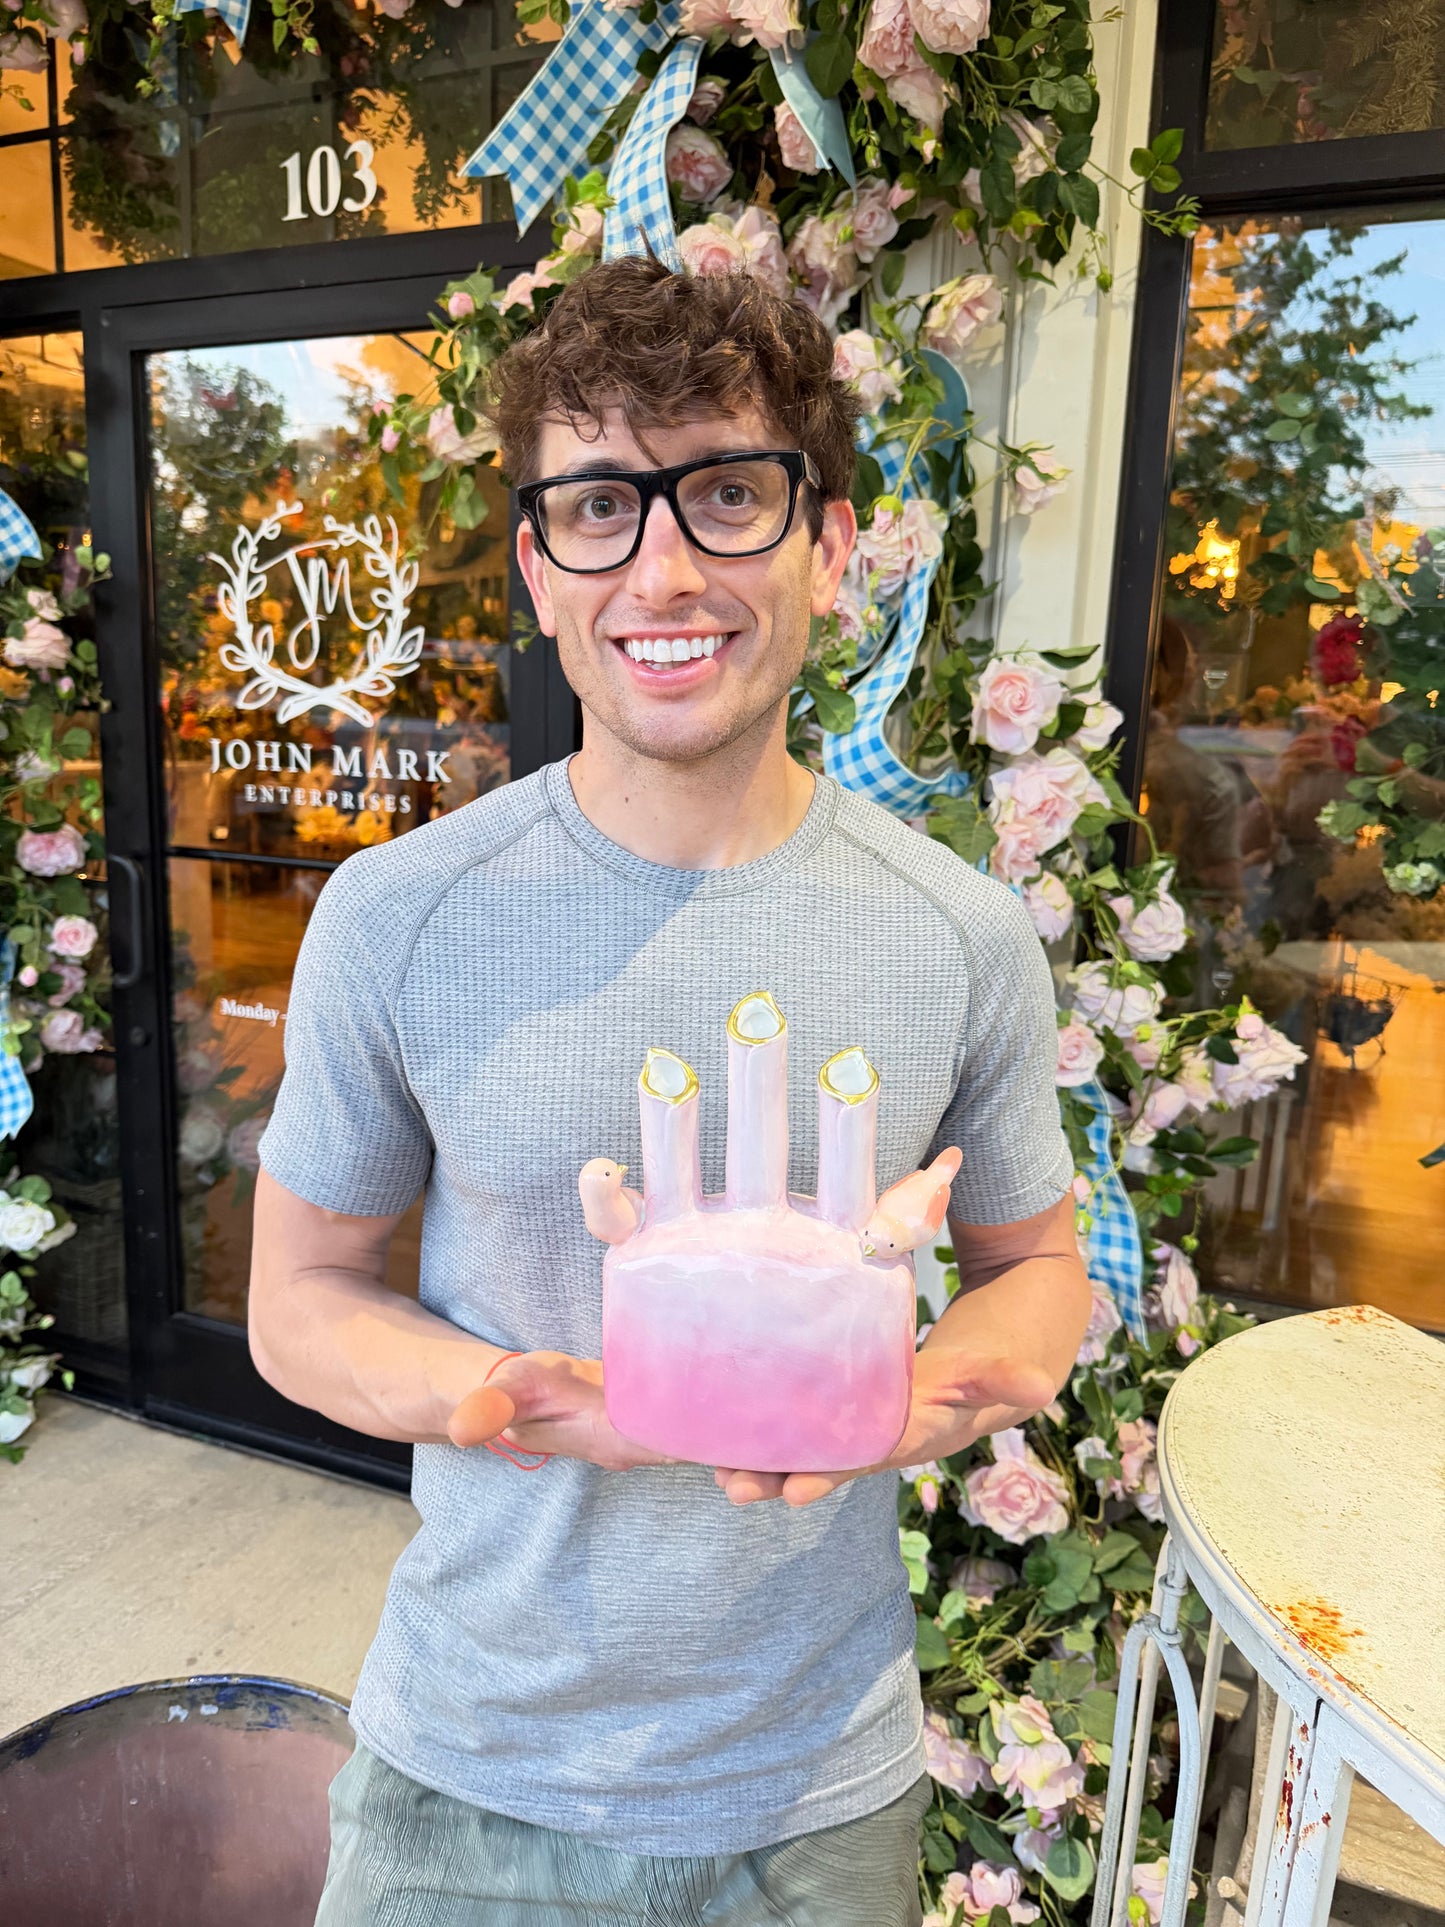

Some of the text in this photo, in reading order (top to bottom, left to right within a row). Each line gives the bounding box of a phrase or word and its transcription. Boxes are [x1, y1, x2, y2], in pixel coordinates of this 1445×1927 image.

[279, 139, 378, 221] 103
[209, 738, 453, 783] JOHN MARK
[244, 783, 413, 814] ENTERPRISES
[220, 998, 280, 1028] Monday
